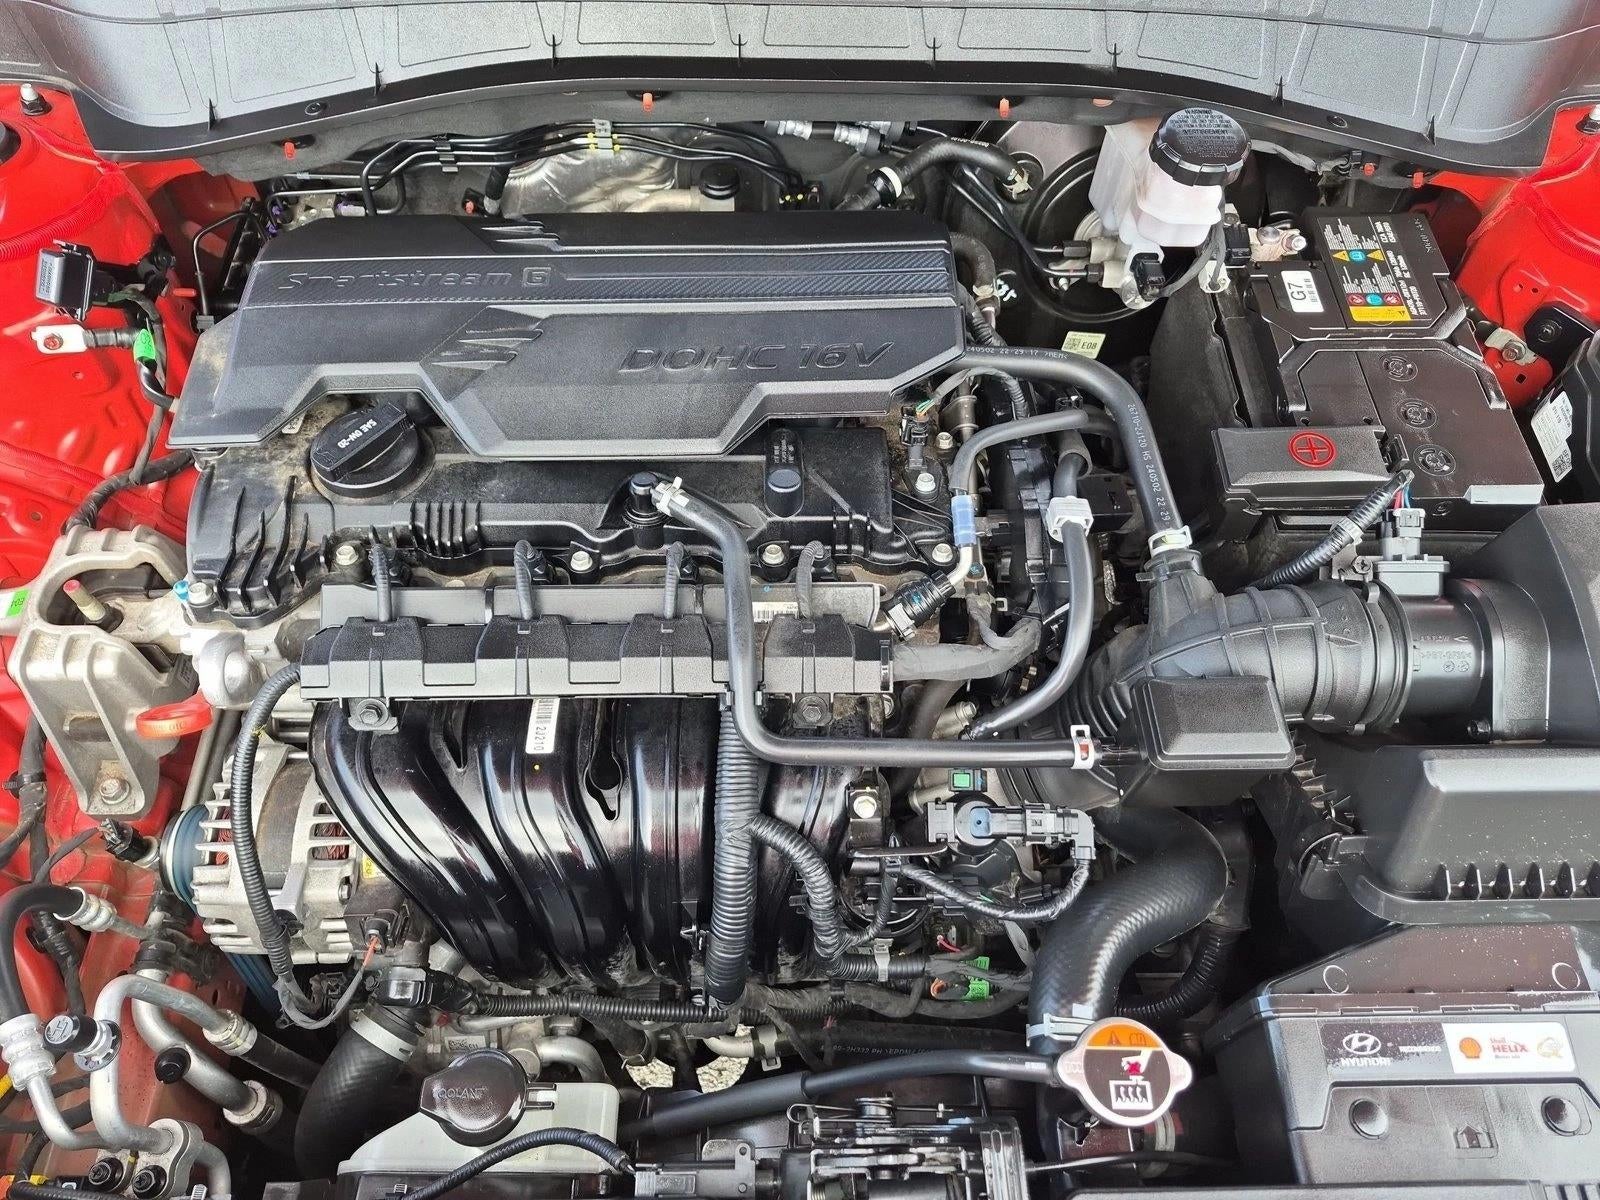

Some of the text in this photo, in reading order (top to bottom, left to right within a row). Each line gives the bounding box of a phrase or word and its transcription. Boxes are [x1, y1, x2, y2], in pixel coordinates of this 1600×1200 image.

[278, 270, 513, 289] Smartstream
[1290, 282, 1307, 301] G7
[618, 341, 895, 373] DOHC 16V
[337, 418, 378, 449] SAE 0W-20
[1492, 1044, 1529, 1053] HELIX
[1340, 1056, 1392, 1067] HYUNDAI
